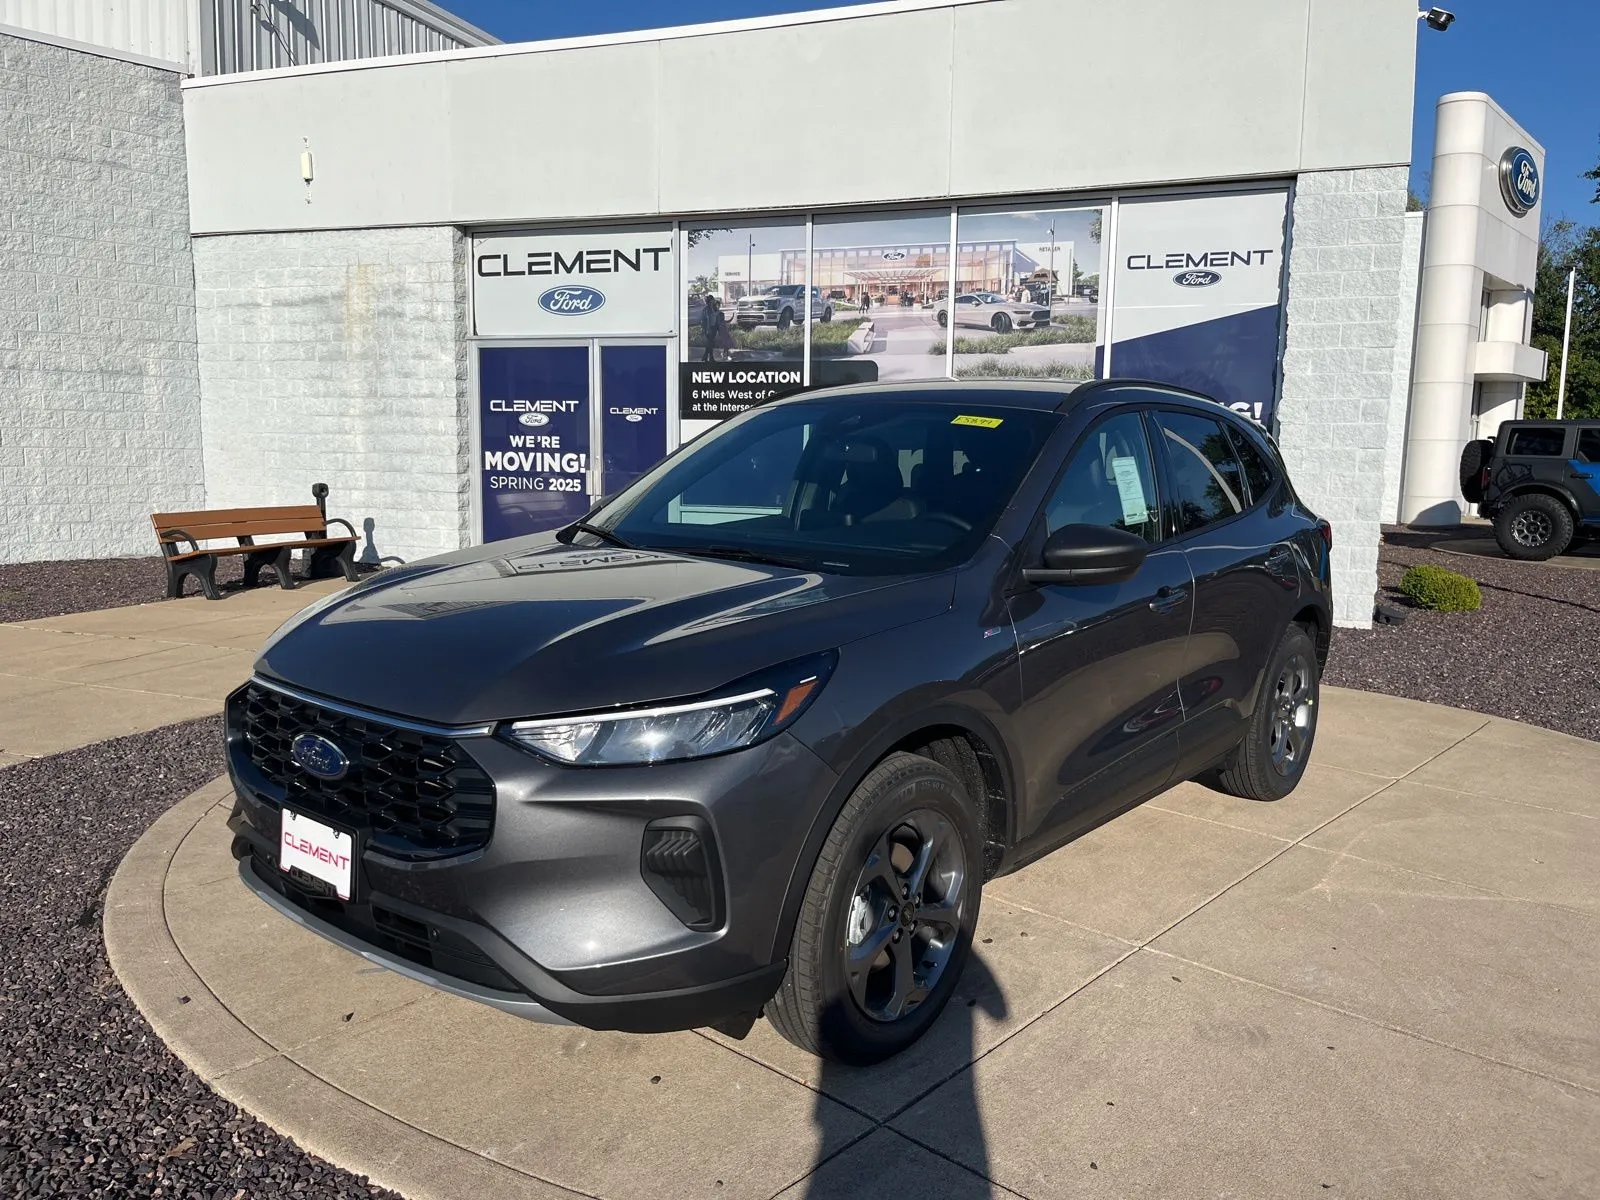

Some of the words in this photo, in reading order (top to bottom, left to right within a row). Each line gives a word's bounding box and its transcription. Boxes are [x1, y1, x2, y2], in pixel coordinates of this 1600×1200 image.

[1517, 160, 1537, 199] Ford
[477, 247, 671, 277] CLEMENT
[1127, 249, 1274, 270] CLEMENT
[1182, 272, 1212, 285] Ford
[550, 289, 592, 311] Ford
[692, 371, 725, 384] NEW
[728, 371, 801, 383] LOCATION
[692, 390, 699, 399] 6
[701, 390, 725, 399] Miles
[727, 390, 753, 399] West
[755, 389, 766, 399] of
[489, 400, 579, 412] CLEMENT
[609, 407, 659, 415] CLEMENT
[692, 403, 702, 411] at
[703, 403, 718, 411] the
[509, 435, 560, 448] WE'RE
[484, 451, 586, 474] MOVING!
[490, 476, 544, 490] SPRING
[548, 478, 582, 492] 2025
[284, 831, 350, 870] CLEMENT
